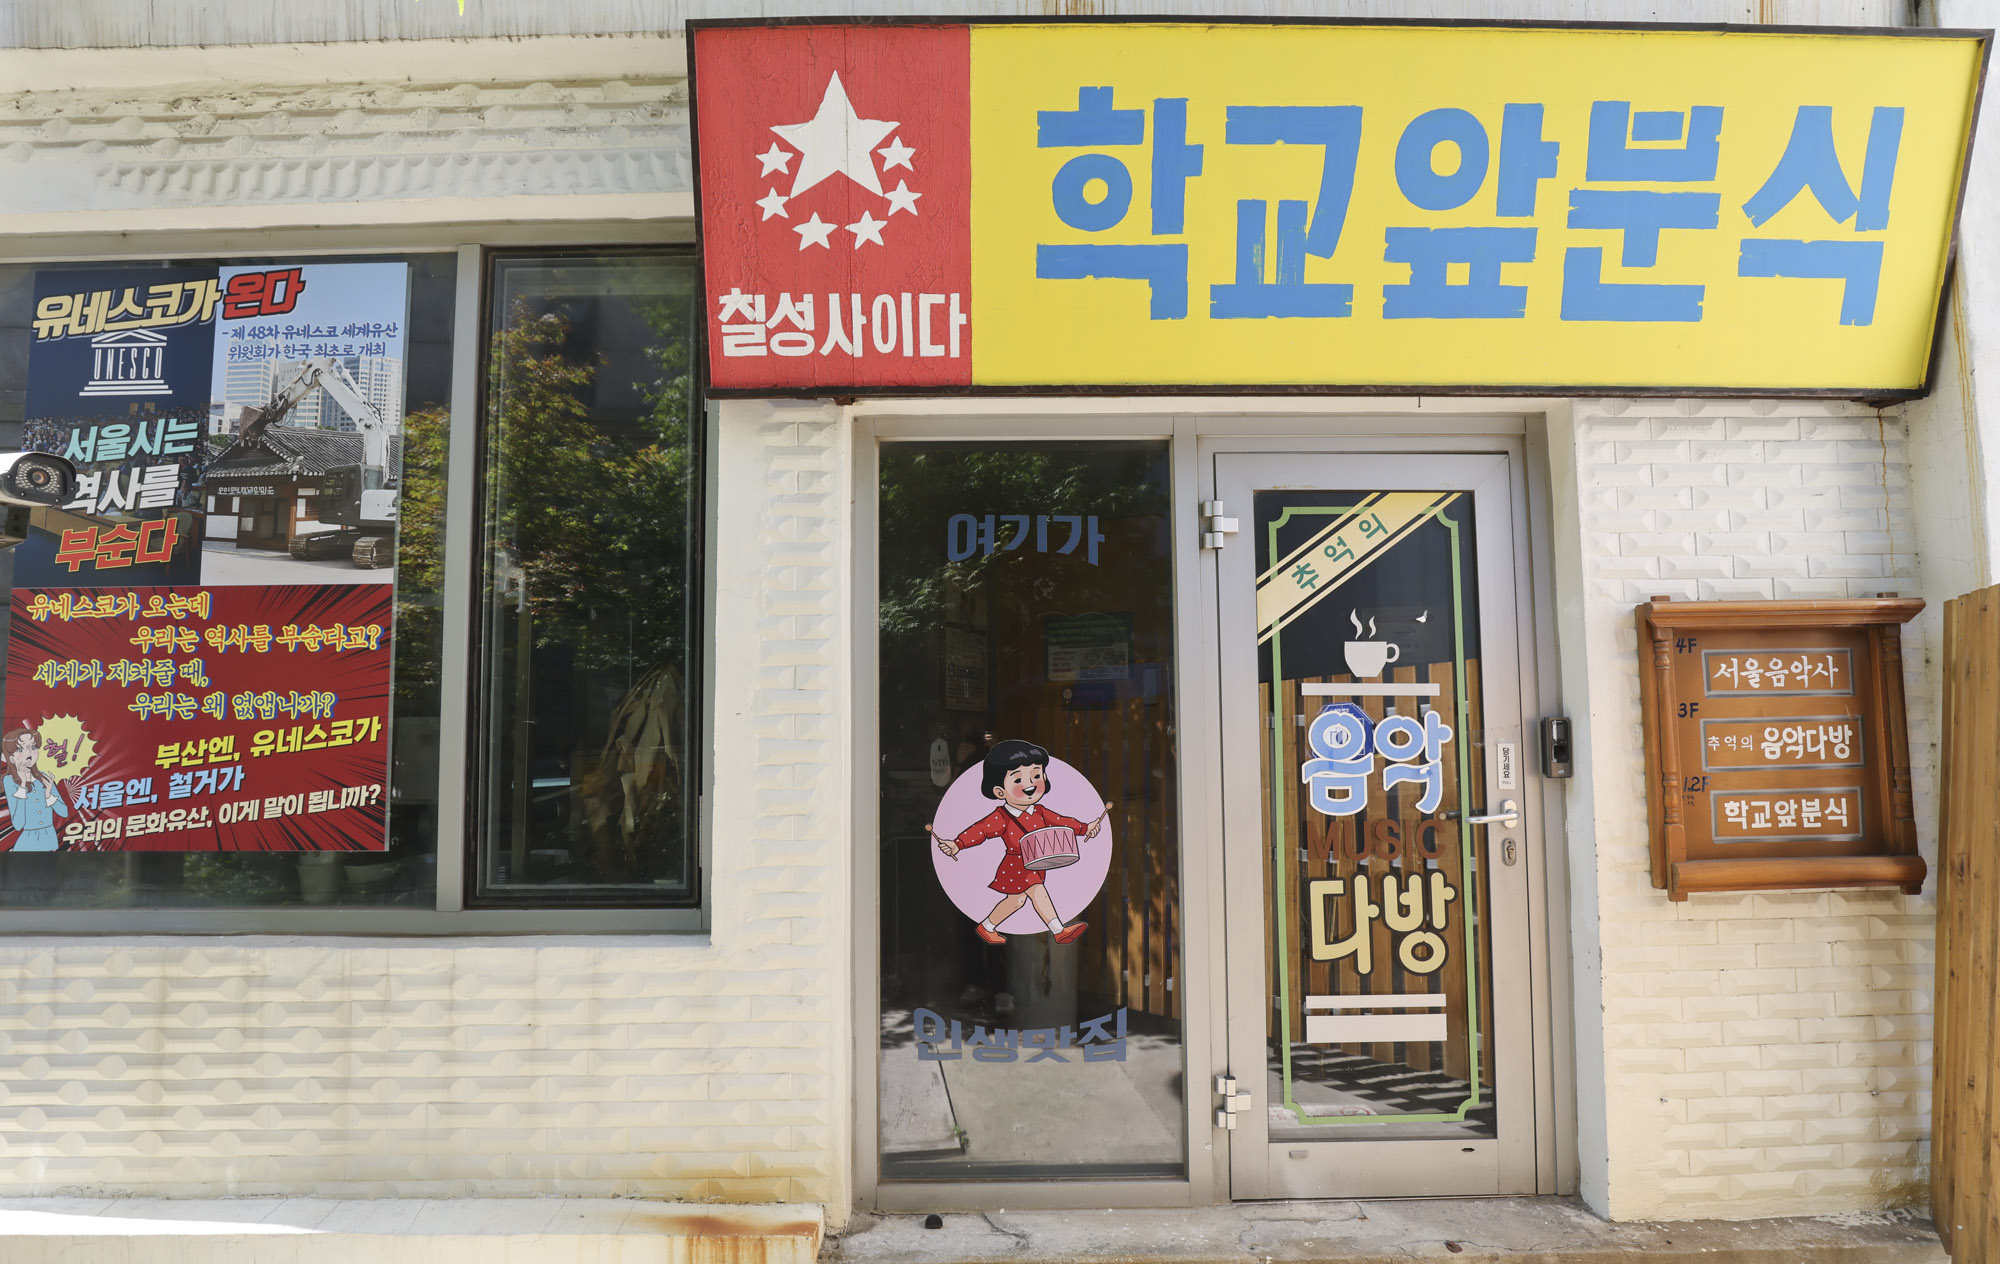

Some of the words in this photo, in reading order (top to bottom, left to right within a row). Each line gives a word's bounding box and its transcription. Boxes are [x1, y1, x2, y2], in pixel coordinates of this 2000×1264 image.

[1036, 86, 1905, 326] 학교앞분식
[32, 277, 222, 340] 유네스코가
[222, 267, 306, 320] 온다
[718, 287, 967, 358] 칠성사이다
[228, 344, 281, 360] 위원회가
[282, 344, 312, 358] 한국
[314, 343, 356, 358] 최초로
[358, 341, 386, 357] 개최
[231, 325, 246, 341] 제
[247, 324, 281, 341] 48차
[341, 322, 398, 339] 세계유산
[93, 347, 164, 380] UNESCO
[63, 418, 199, 463] 서울시는
[62, 463, 180, 515] 역사를
[55, 517, 179, 573] 부순다
[947, 513, 1105, 566] 여기가
[1291, 512, 1388, 589] 추억의
[26, 593, 141, 622] 유네스코가
[142, 591, 212, 620] 오는데
[129, 625, 200, 655] 우리는
[204, 624, 274, 653] 역사를
[275, 623, 383, 653] 부순다고?
[1675, 637, 1697, 653] 4F
[32, 658, 104, 689] 세계가
[106, 658, 176, 688] 지켜줄
[179, 657, 211, 688] 때,
[1712, 655, 1839, 689] 서울음악사
[128, 691, 199, 721] 우리는
[201, 690, 227, 720] 왜
[232, 690, 337, 720] 없앱니까?
[1677, 702, 1699, 718] 3F
[155, 735, 241, 770] 부산엔,
[250, 716, 382, 758] 유네스코가
[1302, 710, 1453, 817] 음악
[1502, 747, 1510, 778] 당기세요
[1760, 724, 1853, 760] 음악다방
[73, 777, 158, 812] 서울엔,
[168, 765, 246, 800] 철거가
[62, 817, 124, 845] 우리의
[125, 806, 213, 837] 문화유산,
[218, 798, 261, 825] 이게
[263, 793, 305, 820] 말이
[308, 783, 382, 814] 됩니까?
[1724, 797, 1848, 830] 학교앞분식
[1306, 818, 1446, 861] MUSIC
[1308, 870, 1458, 975] 다방
[913, 1006, 1127, 1063] 인생맛집
